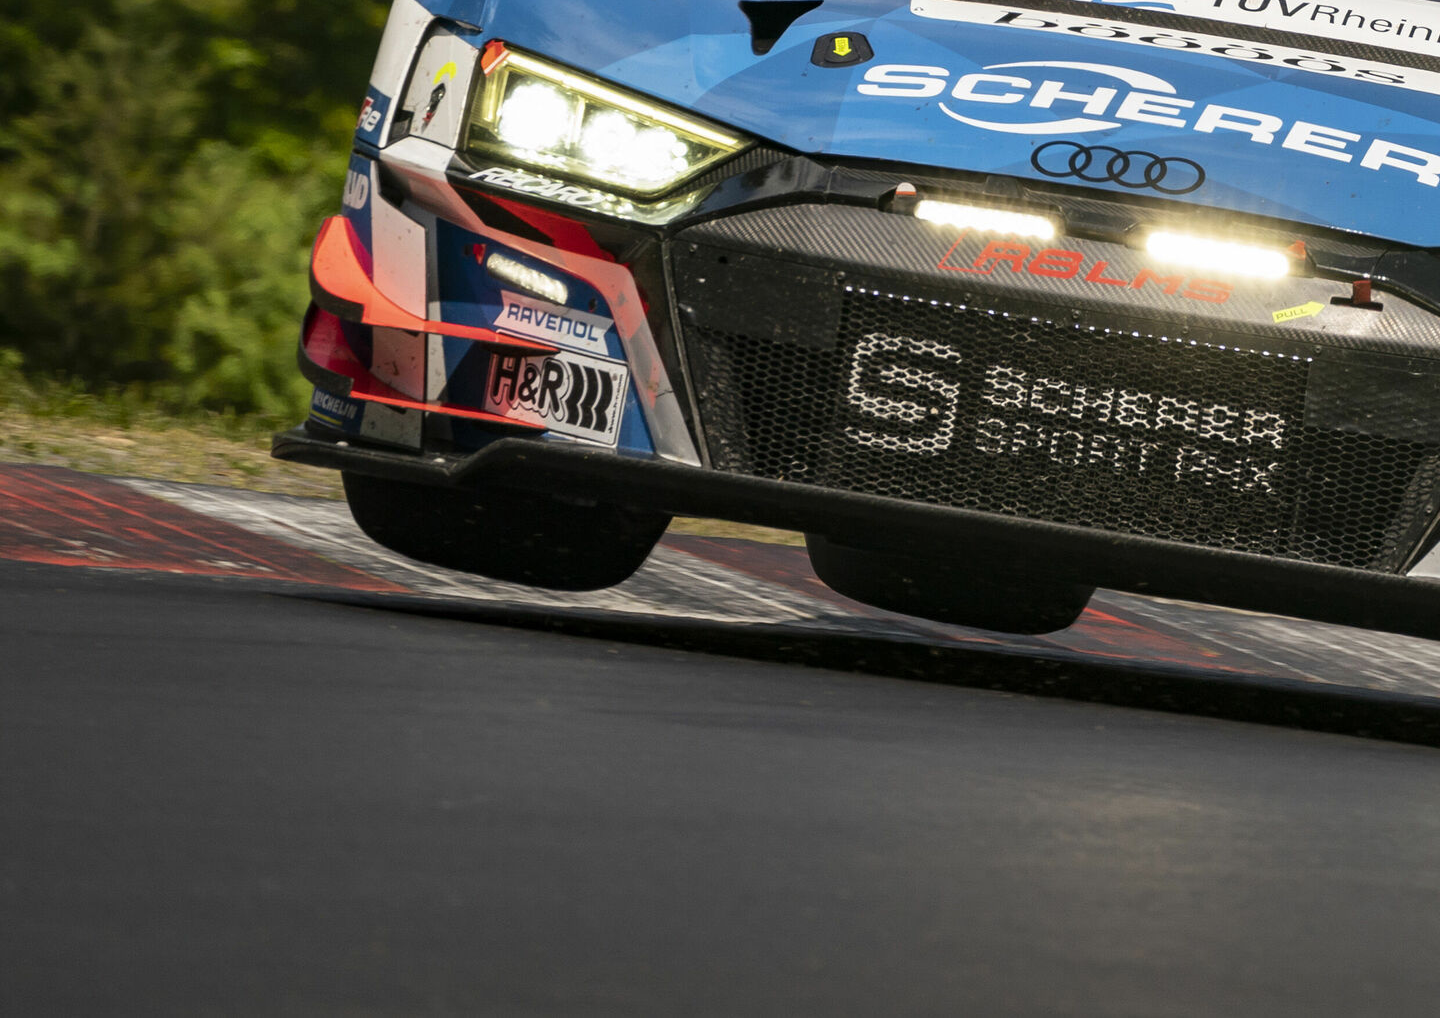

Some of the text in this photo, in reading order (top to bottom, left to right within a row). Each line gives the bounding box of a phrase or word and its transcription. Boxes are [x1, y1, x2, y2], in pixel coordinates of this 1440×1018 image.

[469, 166, 606, 207] RECARO
[1085, 259, 1235, 304] LMS
[507, 302, 599, 343] RAVENOL
[1276, 308, 1308, 320] PULL
[313, 389, 357, 419] MICHELIN
[490, 353, 568, 419] H&R
[983, 364, 1286, 449] SCHERER
